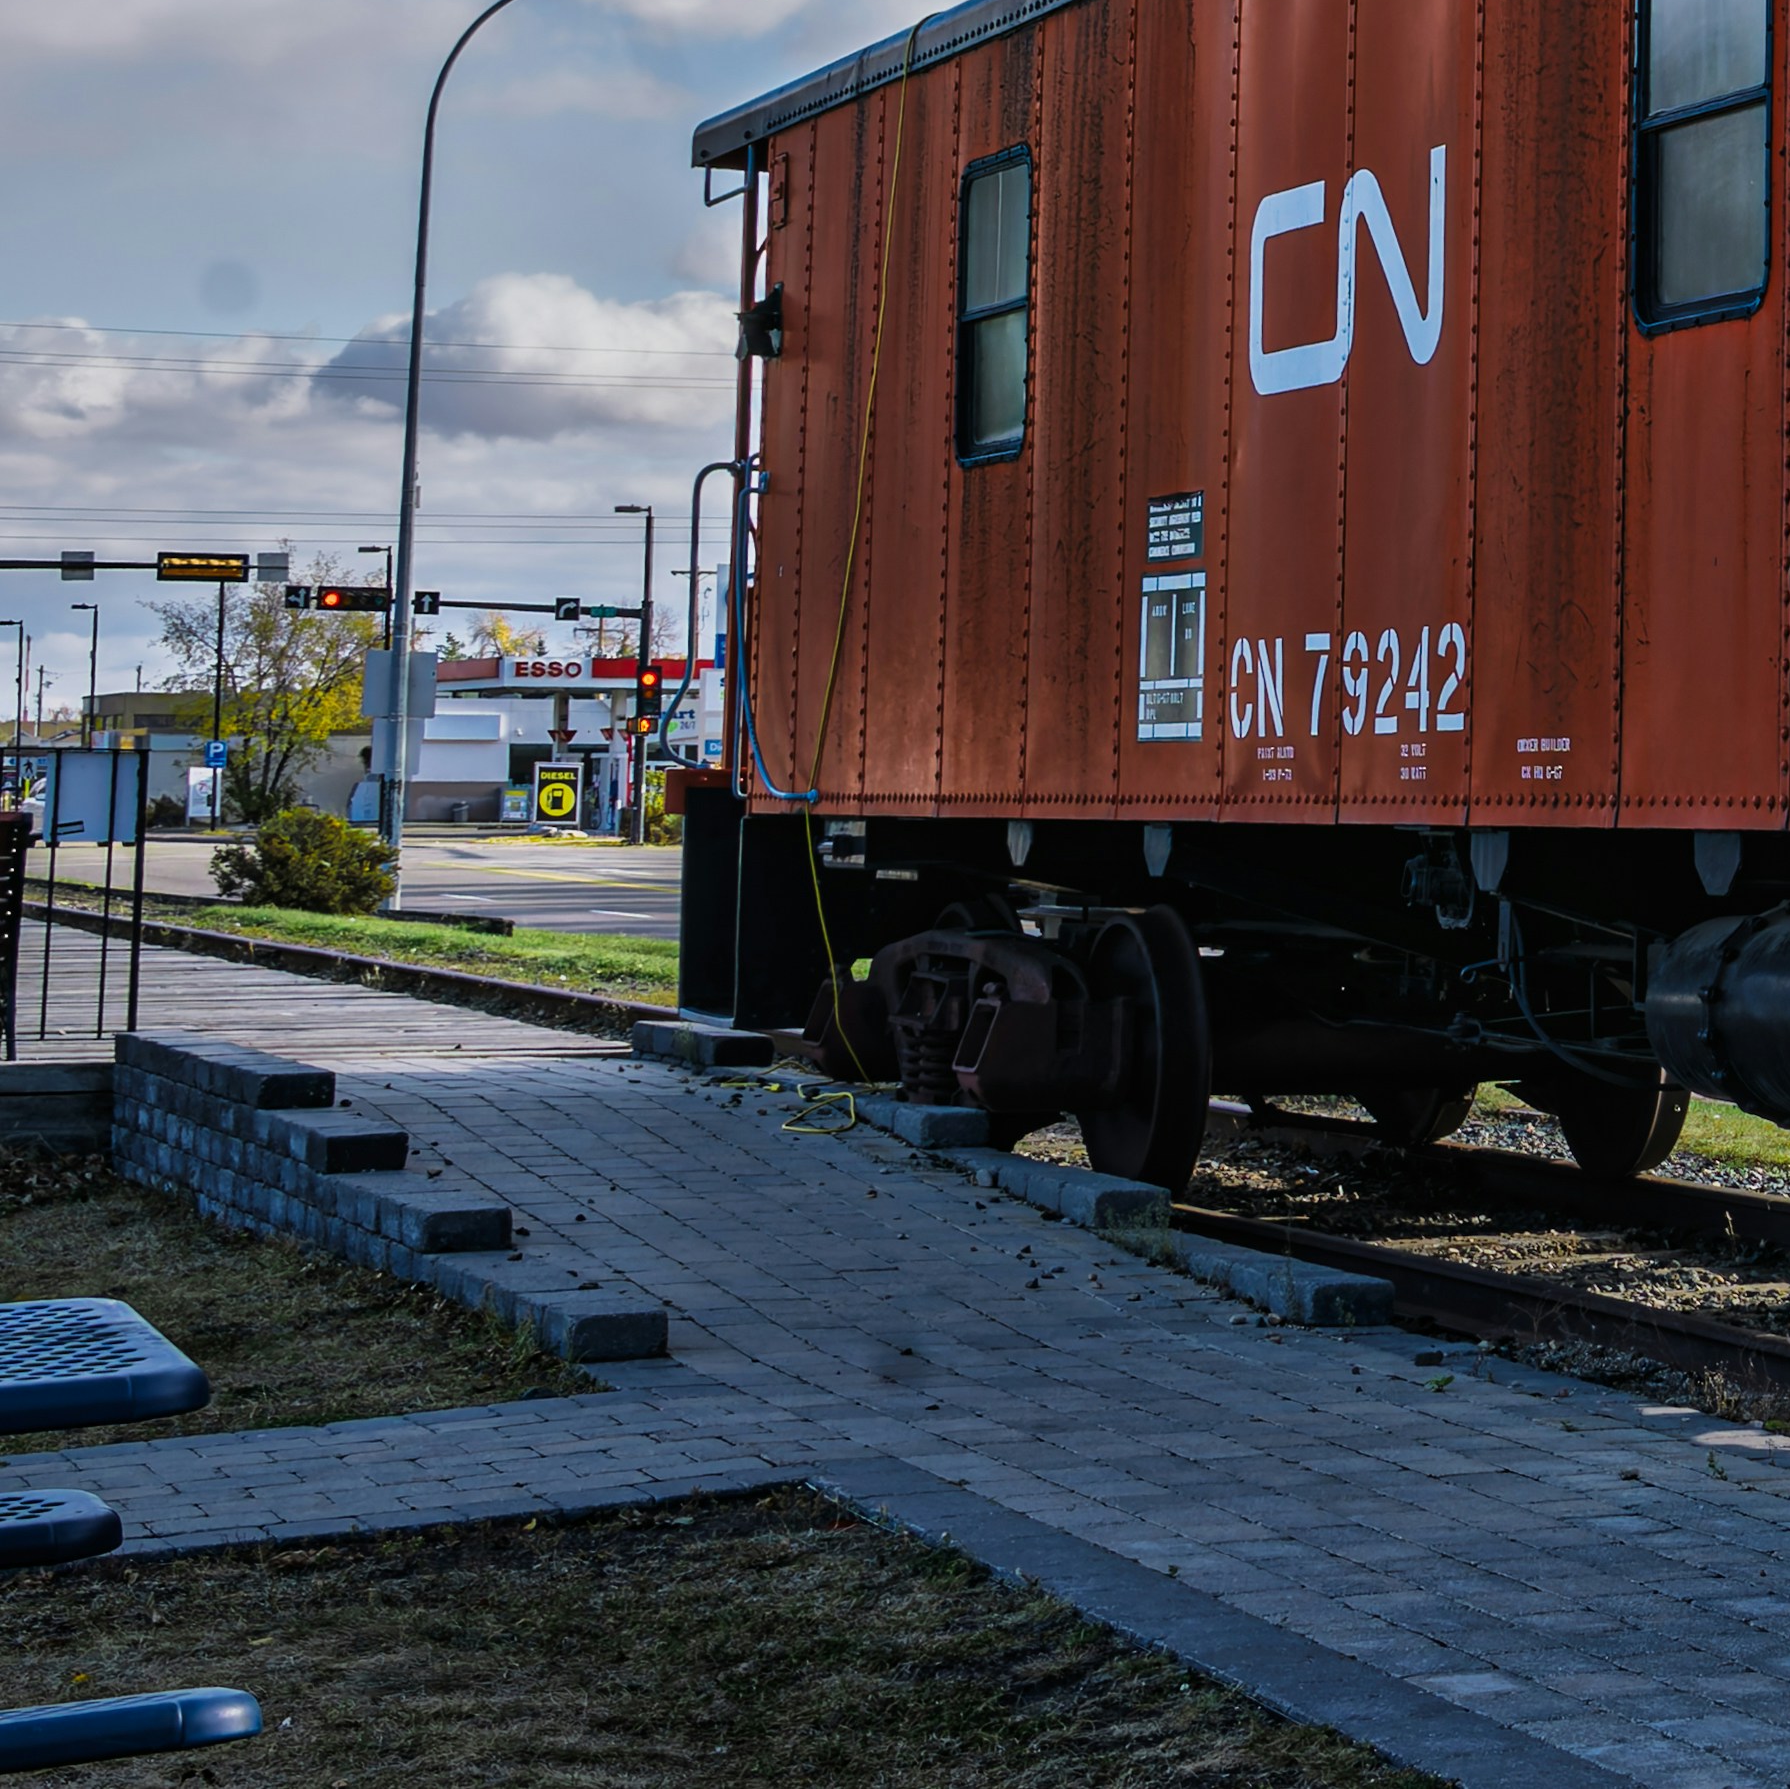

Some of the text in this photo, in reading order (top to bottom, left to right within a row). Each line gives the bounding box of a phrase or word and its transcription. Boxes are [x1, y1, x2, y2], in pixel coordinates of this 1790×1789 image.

[1249, 144, 1446, 396] CN
[515, 661, 582, 678] ESSO
[1230, 621, 1467, 739] CN 79242
[209, 742, 225, 758] P
[540, 771, 577, 780] DIESEL
